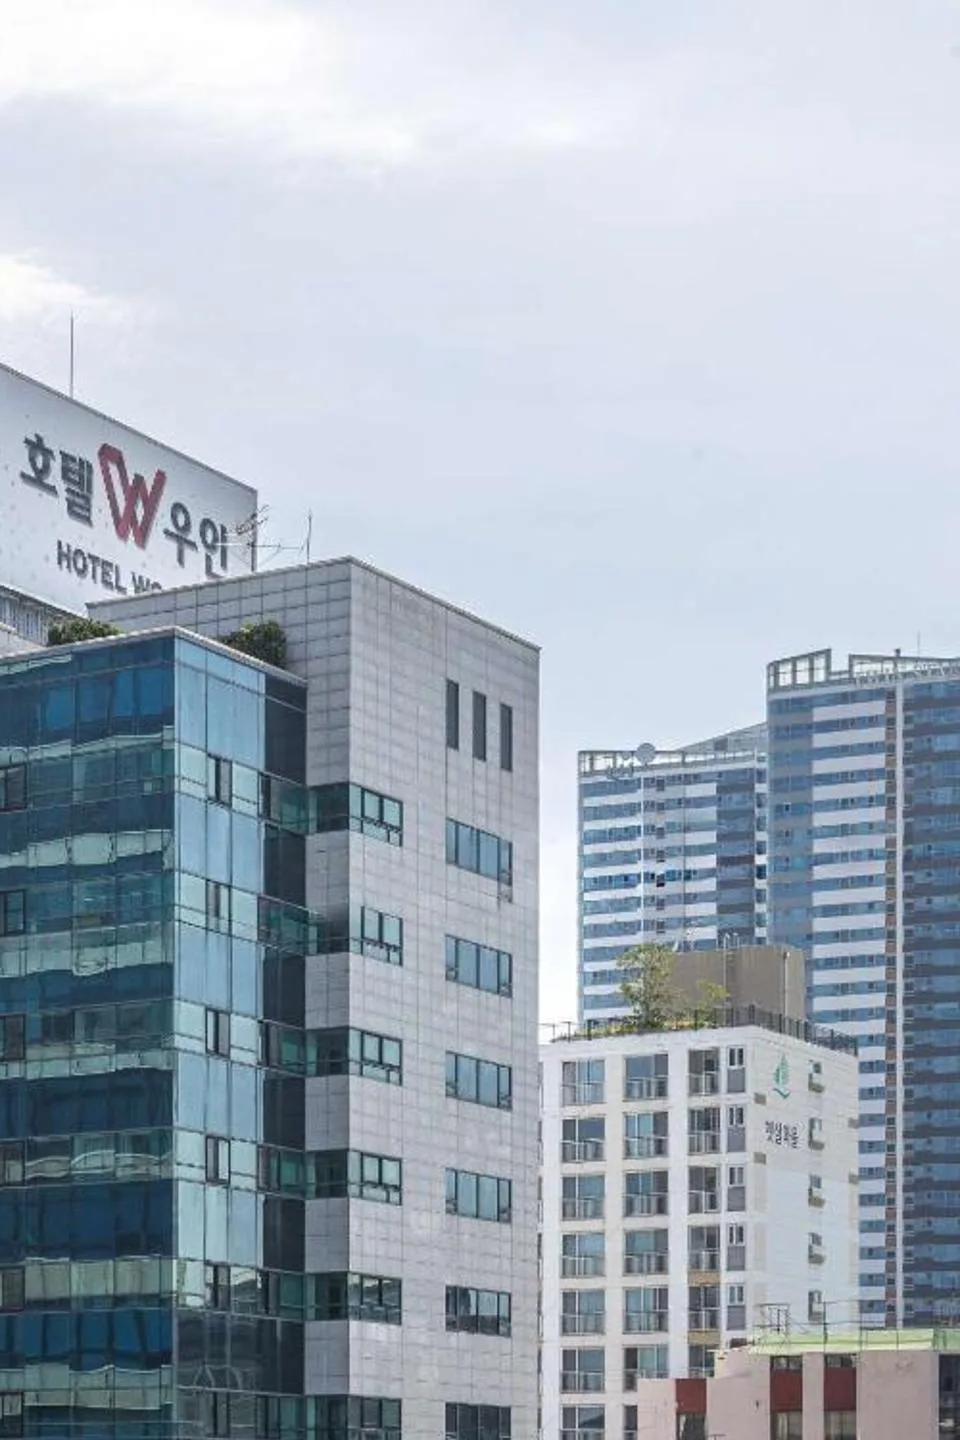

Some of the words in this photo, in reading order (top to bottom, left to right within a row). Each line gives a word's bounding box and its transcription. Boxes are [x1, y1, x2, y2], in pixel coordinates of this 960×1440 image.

[20, 433, 94, 528] 호텔
[163, 502, 229, 579] 우인
[56, 539, 127, 595] HOTEL
